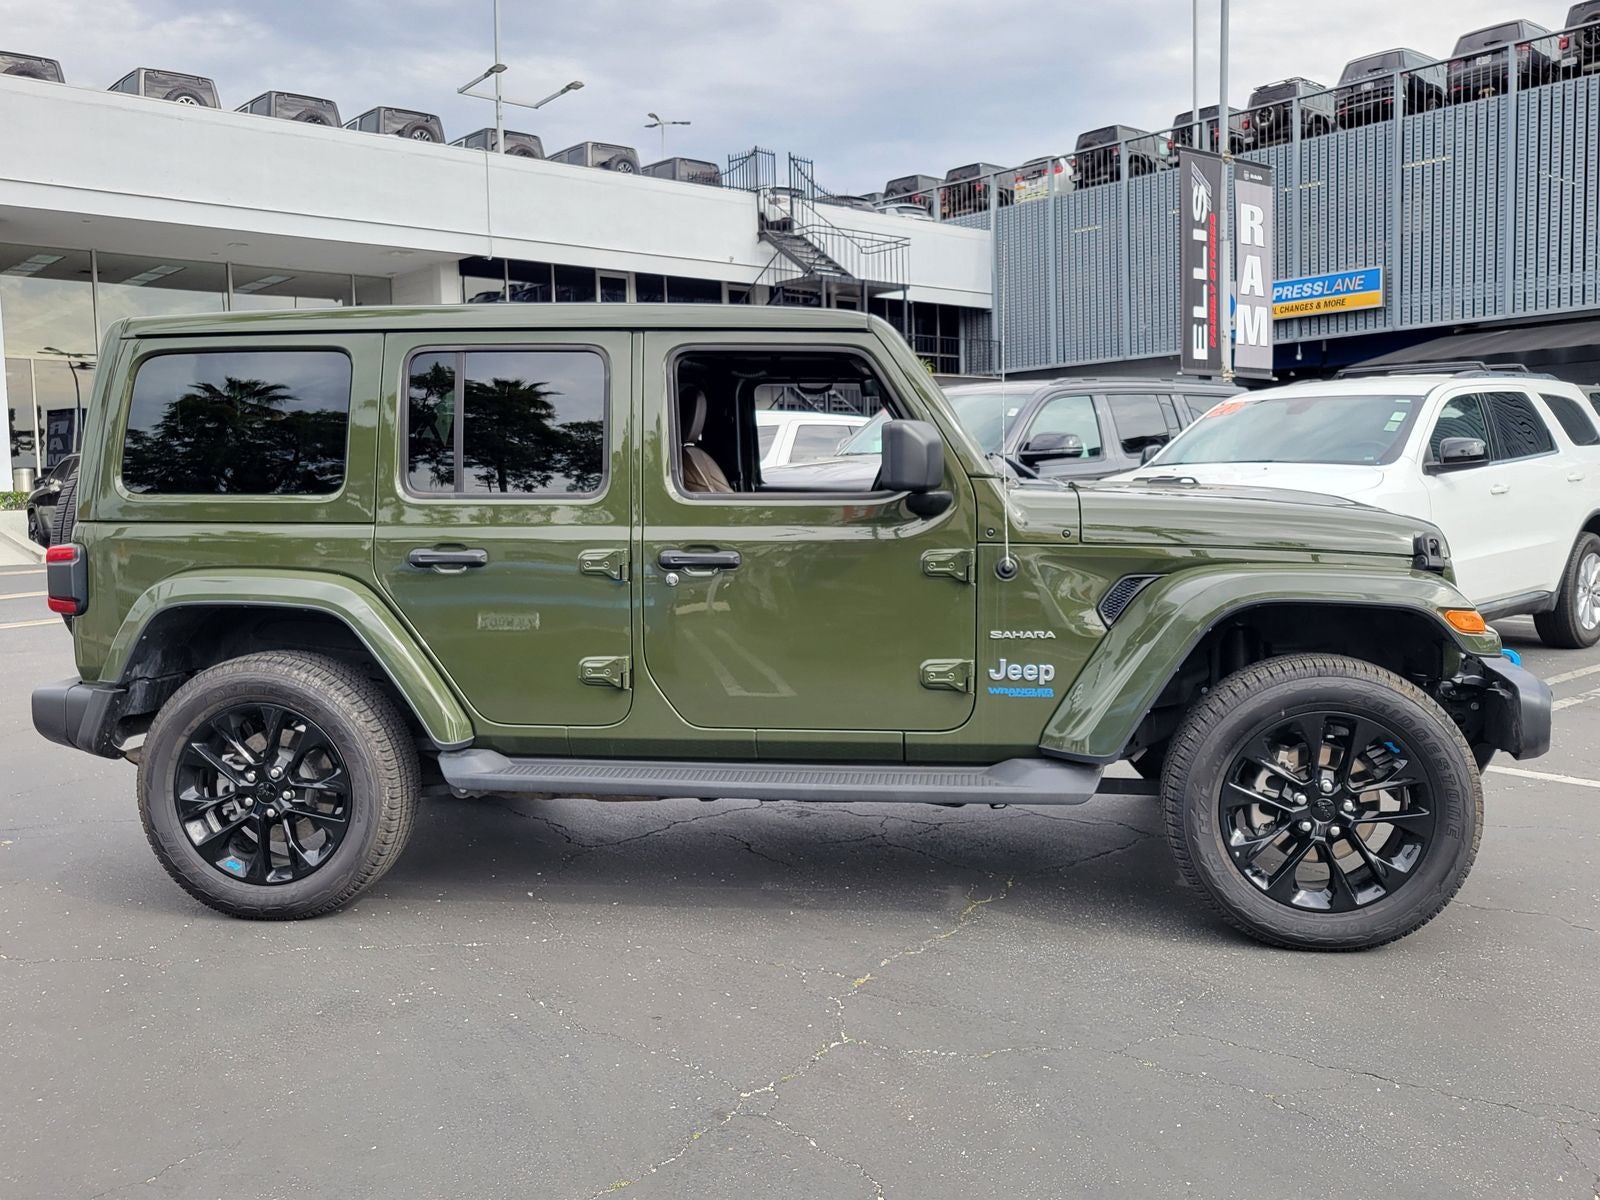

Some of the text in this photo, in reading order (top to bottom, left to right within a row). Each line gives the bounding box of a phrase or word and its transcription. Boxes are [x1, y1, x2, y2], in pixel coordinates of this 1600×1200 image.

[1192, 183, 1209, 360] ELLIS
[1237, 203, 1268, 347] RAM
[1280, 303, 1314, 314] CHANGES
[1315, 301, 1321, 309] &
[1323, 298, 1347, 308] MORE
[988, 658, 1055, 685] Jeep
[990, 630, 1056, 639] SAHARA
[1352, 694, 1461, 841] BRIDGESTONE
